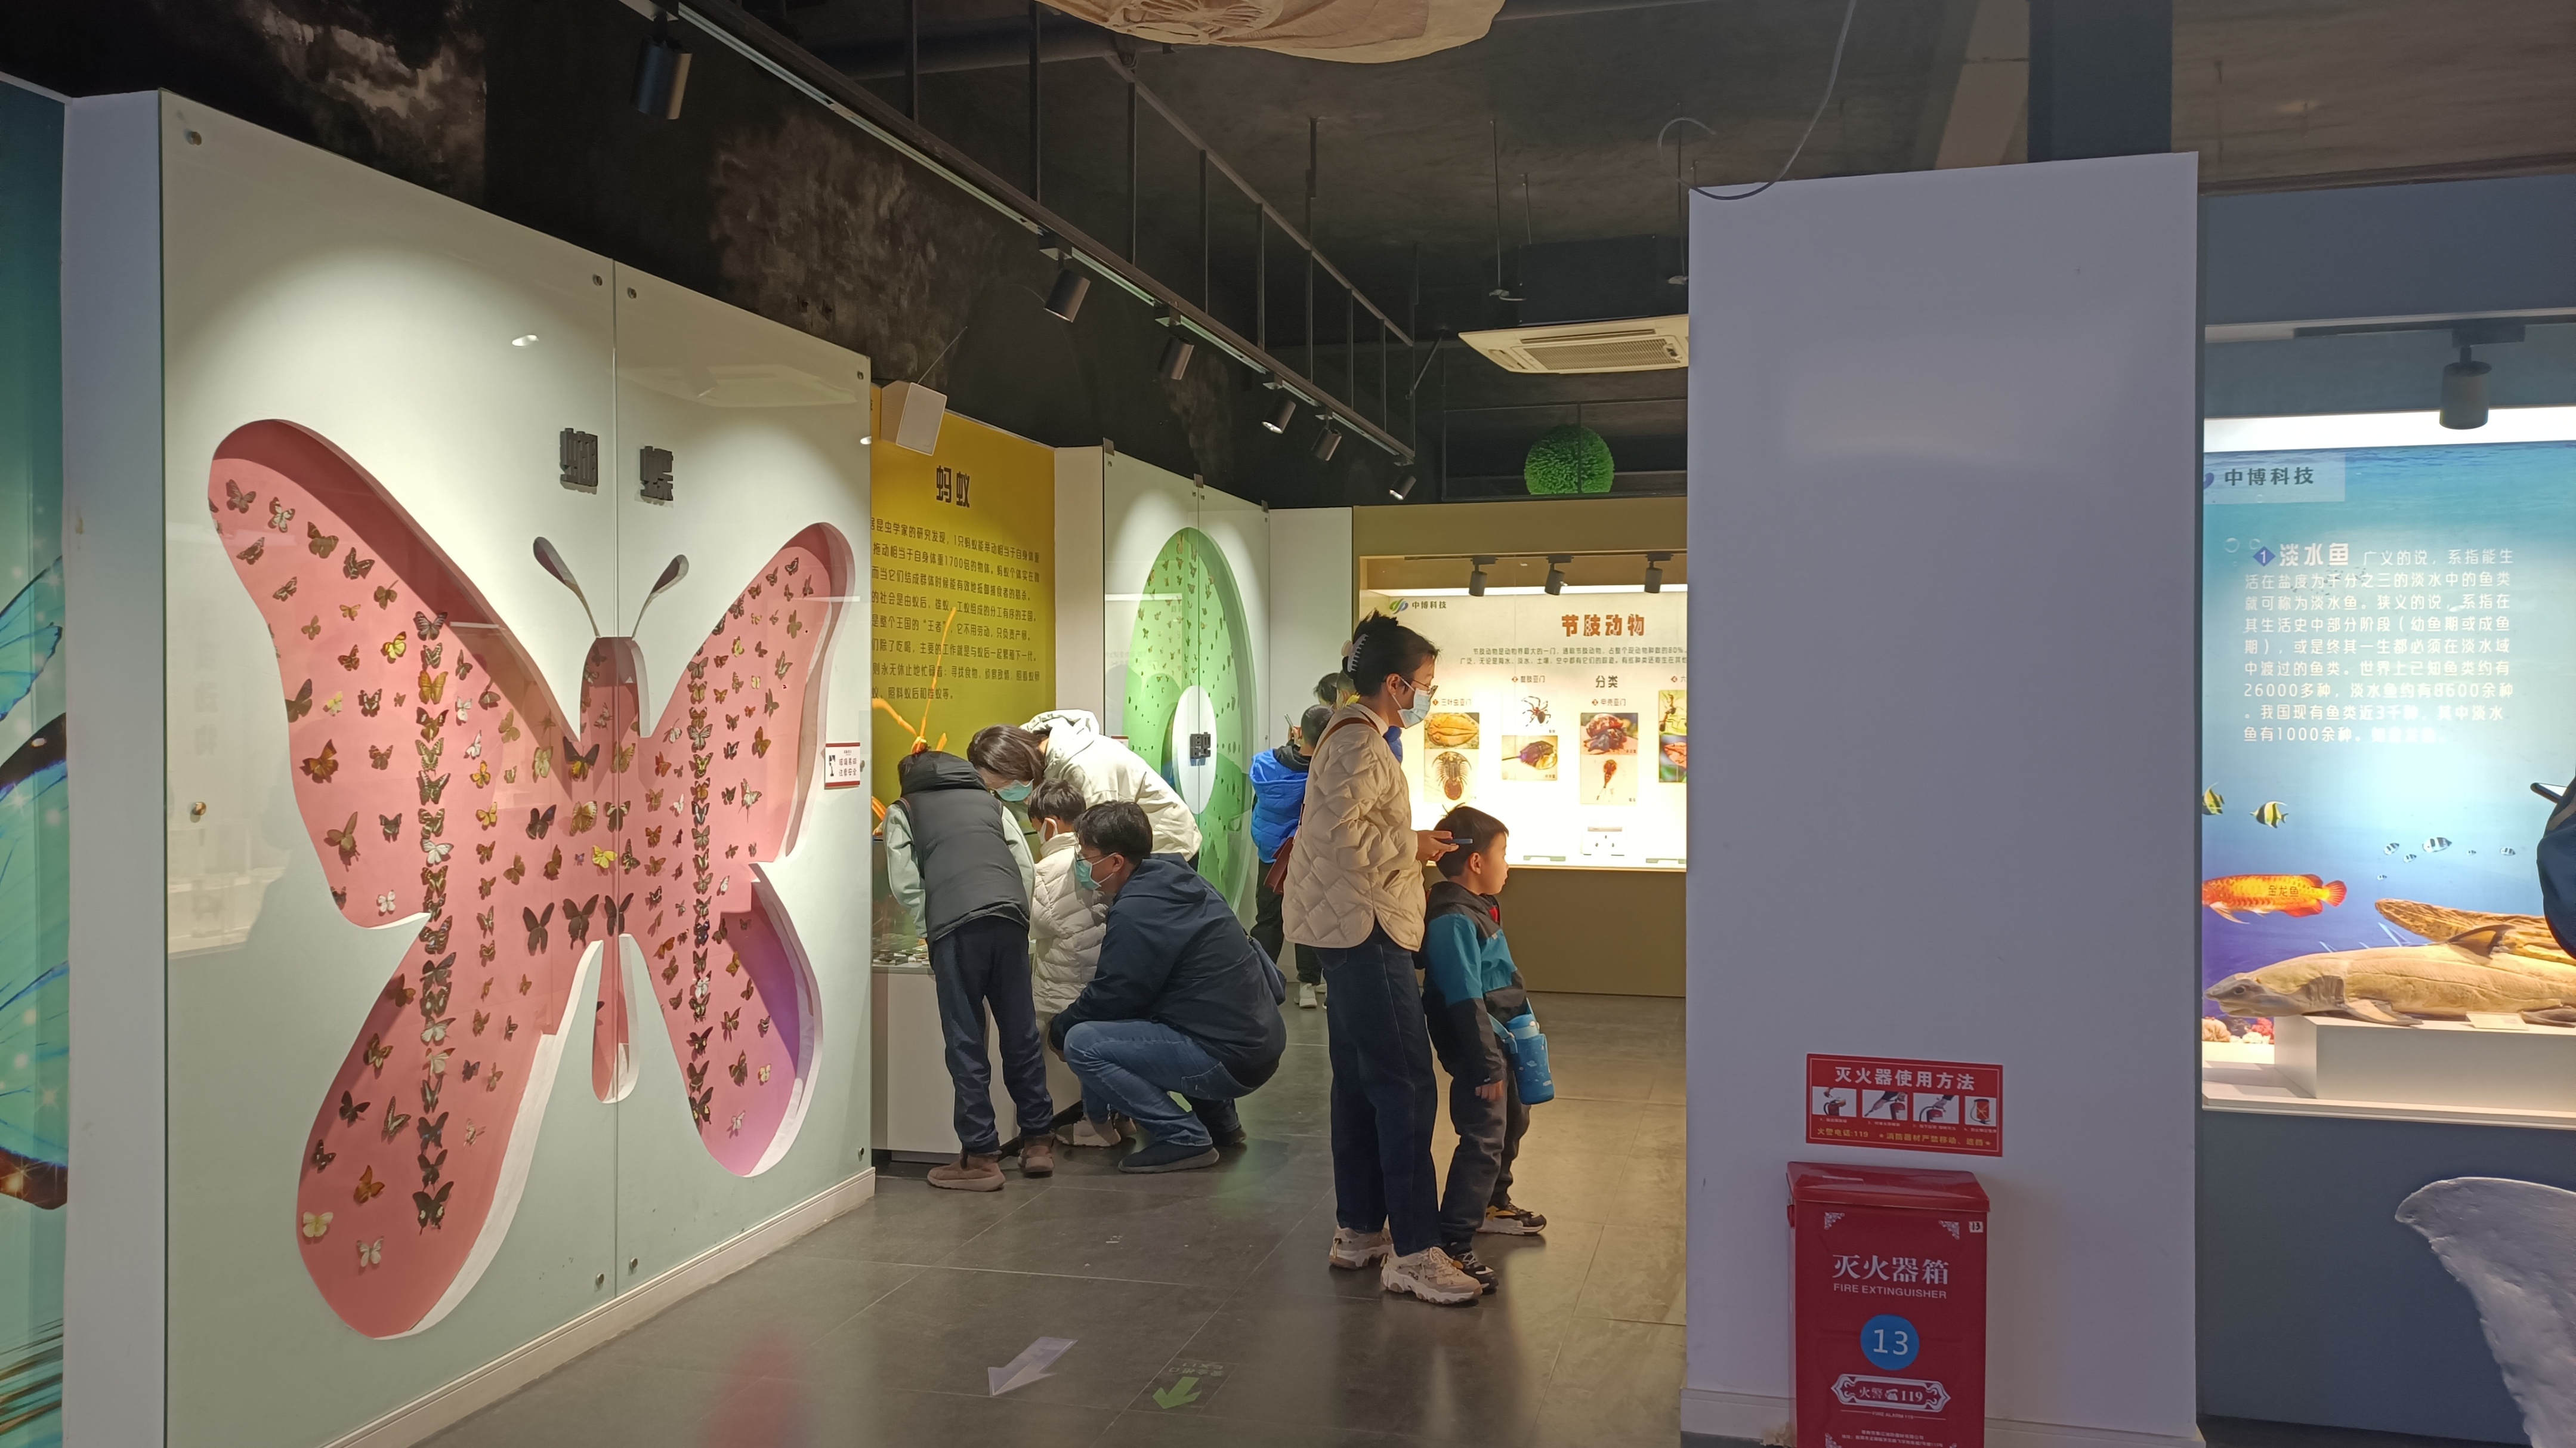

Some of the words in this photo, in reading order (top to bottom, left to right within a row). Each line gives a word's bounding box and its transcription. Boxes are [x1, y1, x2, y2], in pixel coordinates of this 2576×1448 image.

[2224, 467, 2314, 486] 中博科技
[936, 465, 970, 508] 蚂蚁
[2280, 542, 2349, 566] 淡水鱼
[2244, 571, 2511, 590] 活在盐度为千分之三的淡水中的鱼类
[1411, 601, 1447, 609] 中博科技
[1561, 614, 1645, 637] 节肢动物
[1596, 675, 1618, 688] 分类
[2268, 885, 2299, 897] 金龙鱼
[1835, 1066, 1975, 1091] 灭火器使用方法
[1832, 1255, 1949, 1285] 灭火器箱
[1834, 1283, 1858, 1293] FIRE
[1862, 1285, 1947, 1299] EXTINGUISHER
[1873, 1329, 1908, 1355] 13
[1902, 1391, 1923, 1401] 119
